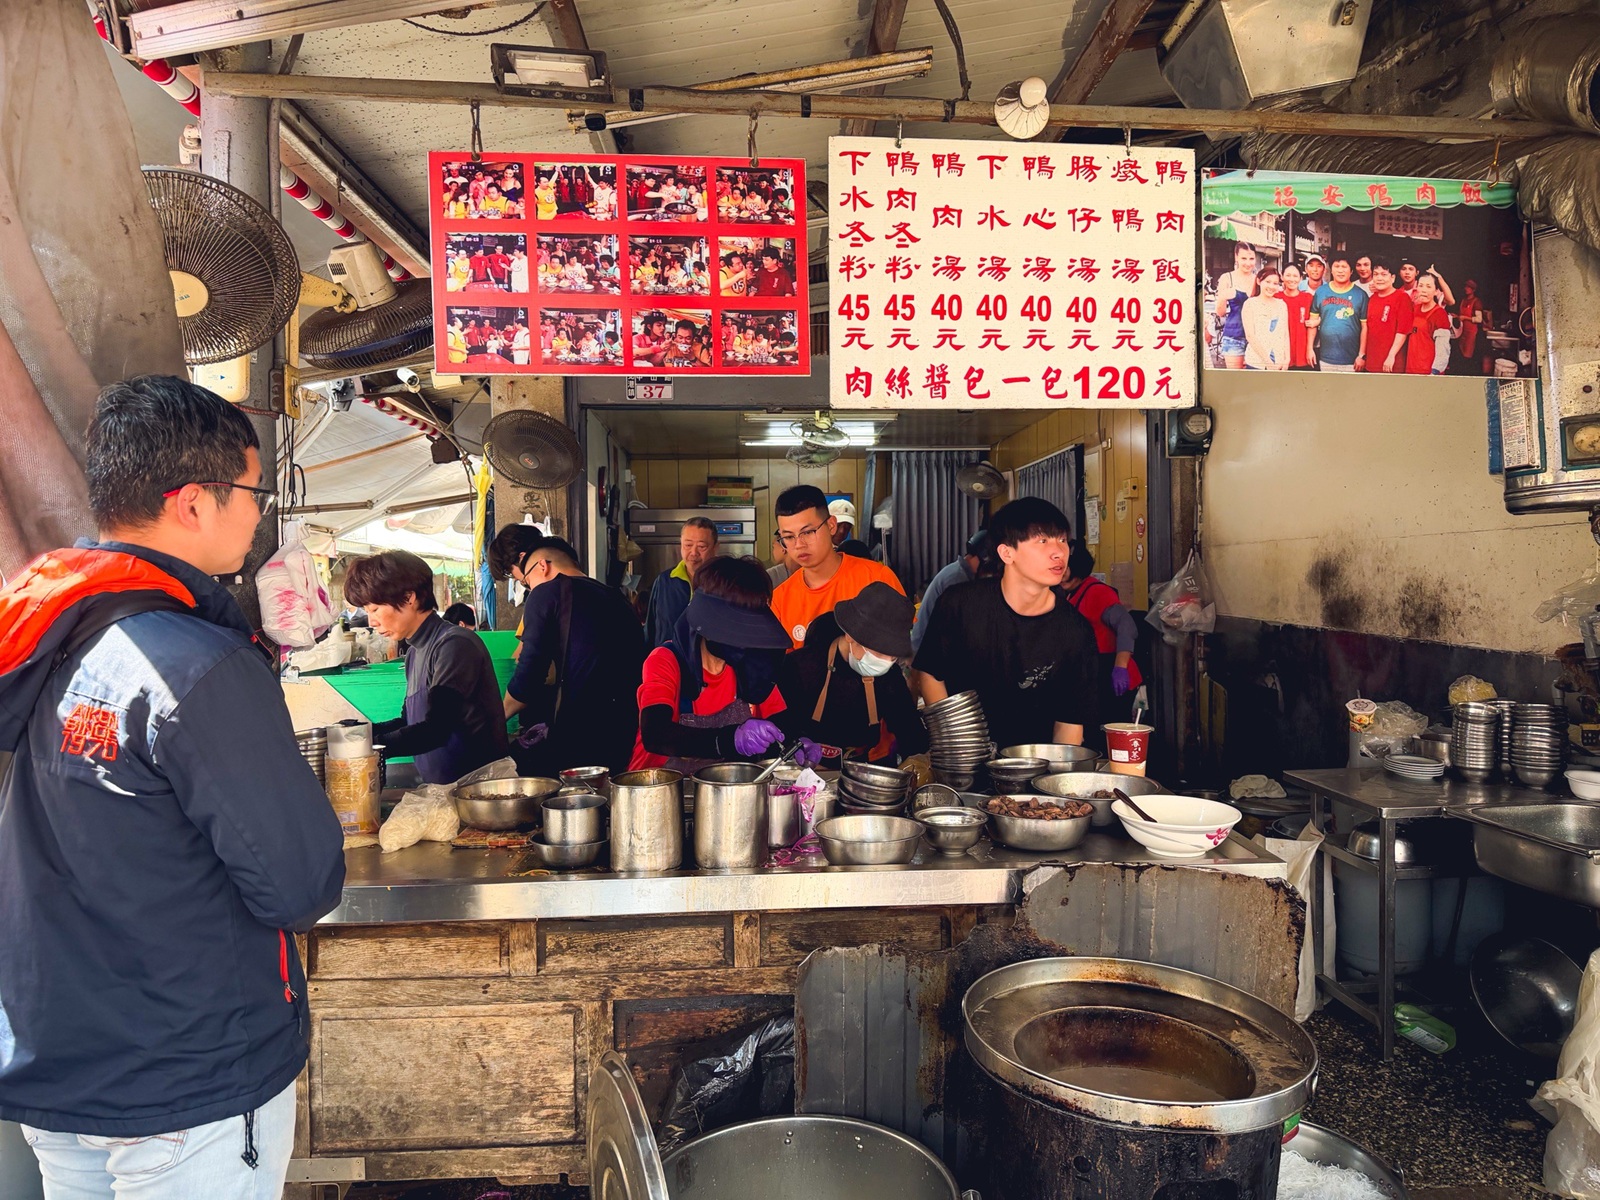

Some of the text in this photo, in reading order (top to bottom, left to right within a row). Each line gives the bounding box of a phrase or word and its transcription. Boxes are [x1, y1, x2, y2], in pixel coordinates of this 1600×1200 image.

[1274, 182, 1486, 207] 福安鴨肉飯
[643, 385, 665, 399] 37
[60, 730, 118, 761] 1970
